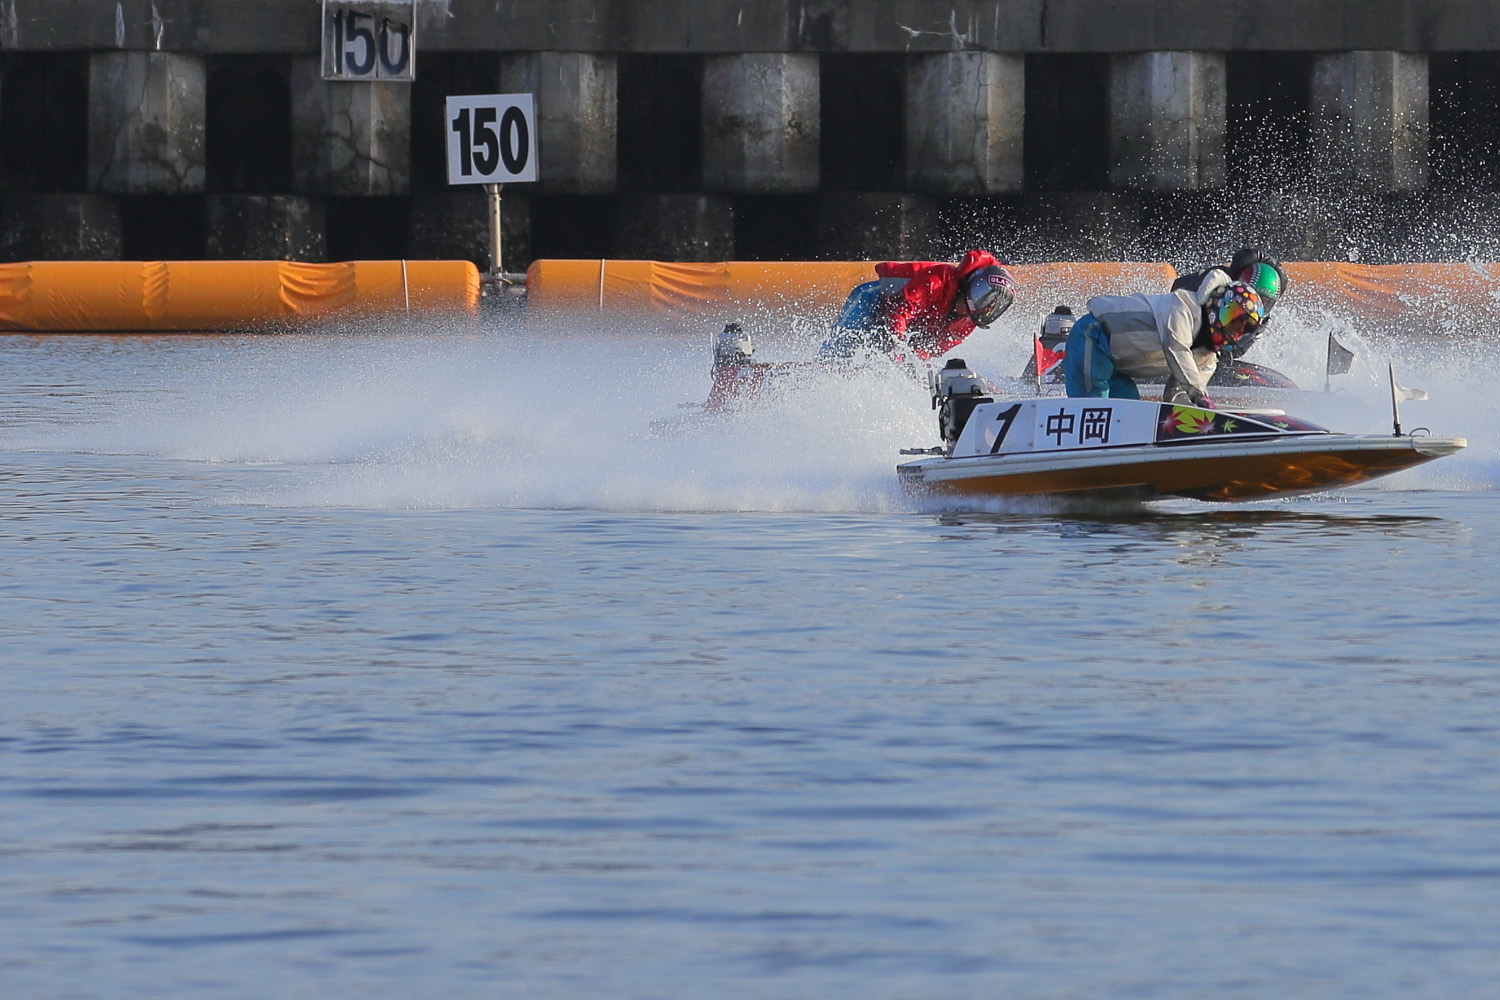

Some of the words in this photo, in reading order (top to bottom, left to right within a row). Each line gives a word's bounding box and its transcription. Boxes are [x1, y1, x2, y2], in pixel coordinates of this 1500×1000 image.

[333, 8, 410, 76] 150
[452, 106, 529, 176] 150
[990, 403, 1023, 454] 1
[1046, 407, 1113, 446] 中岡
